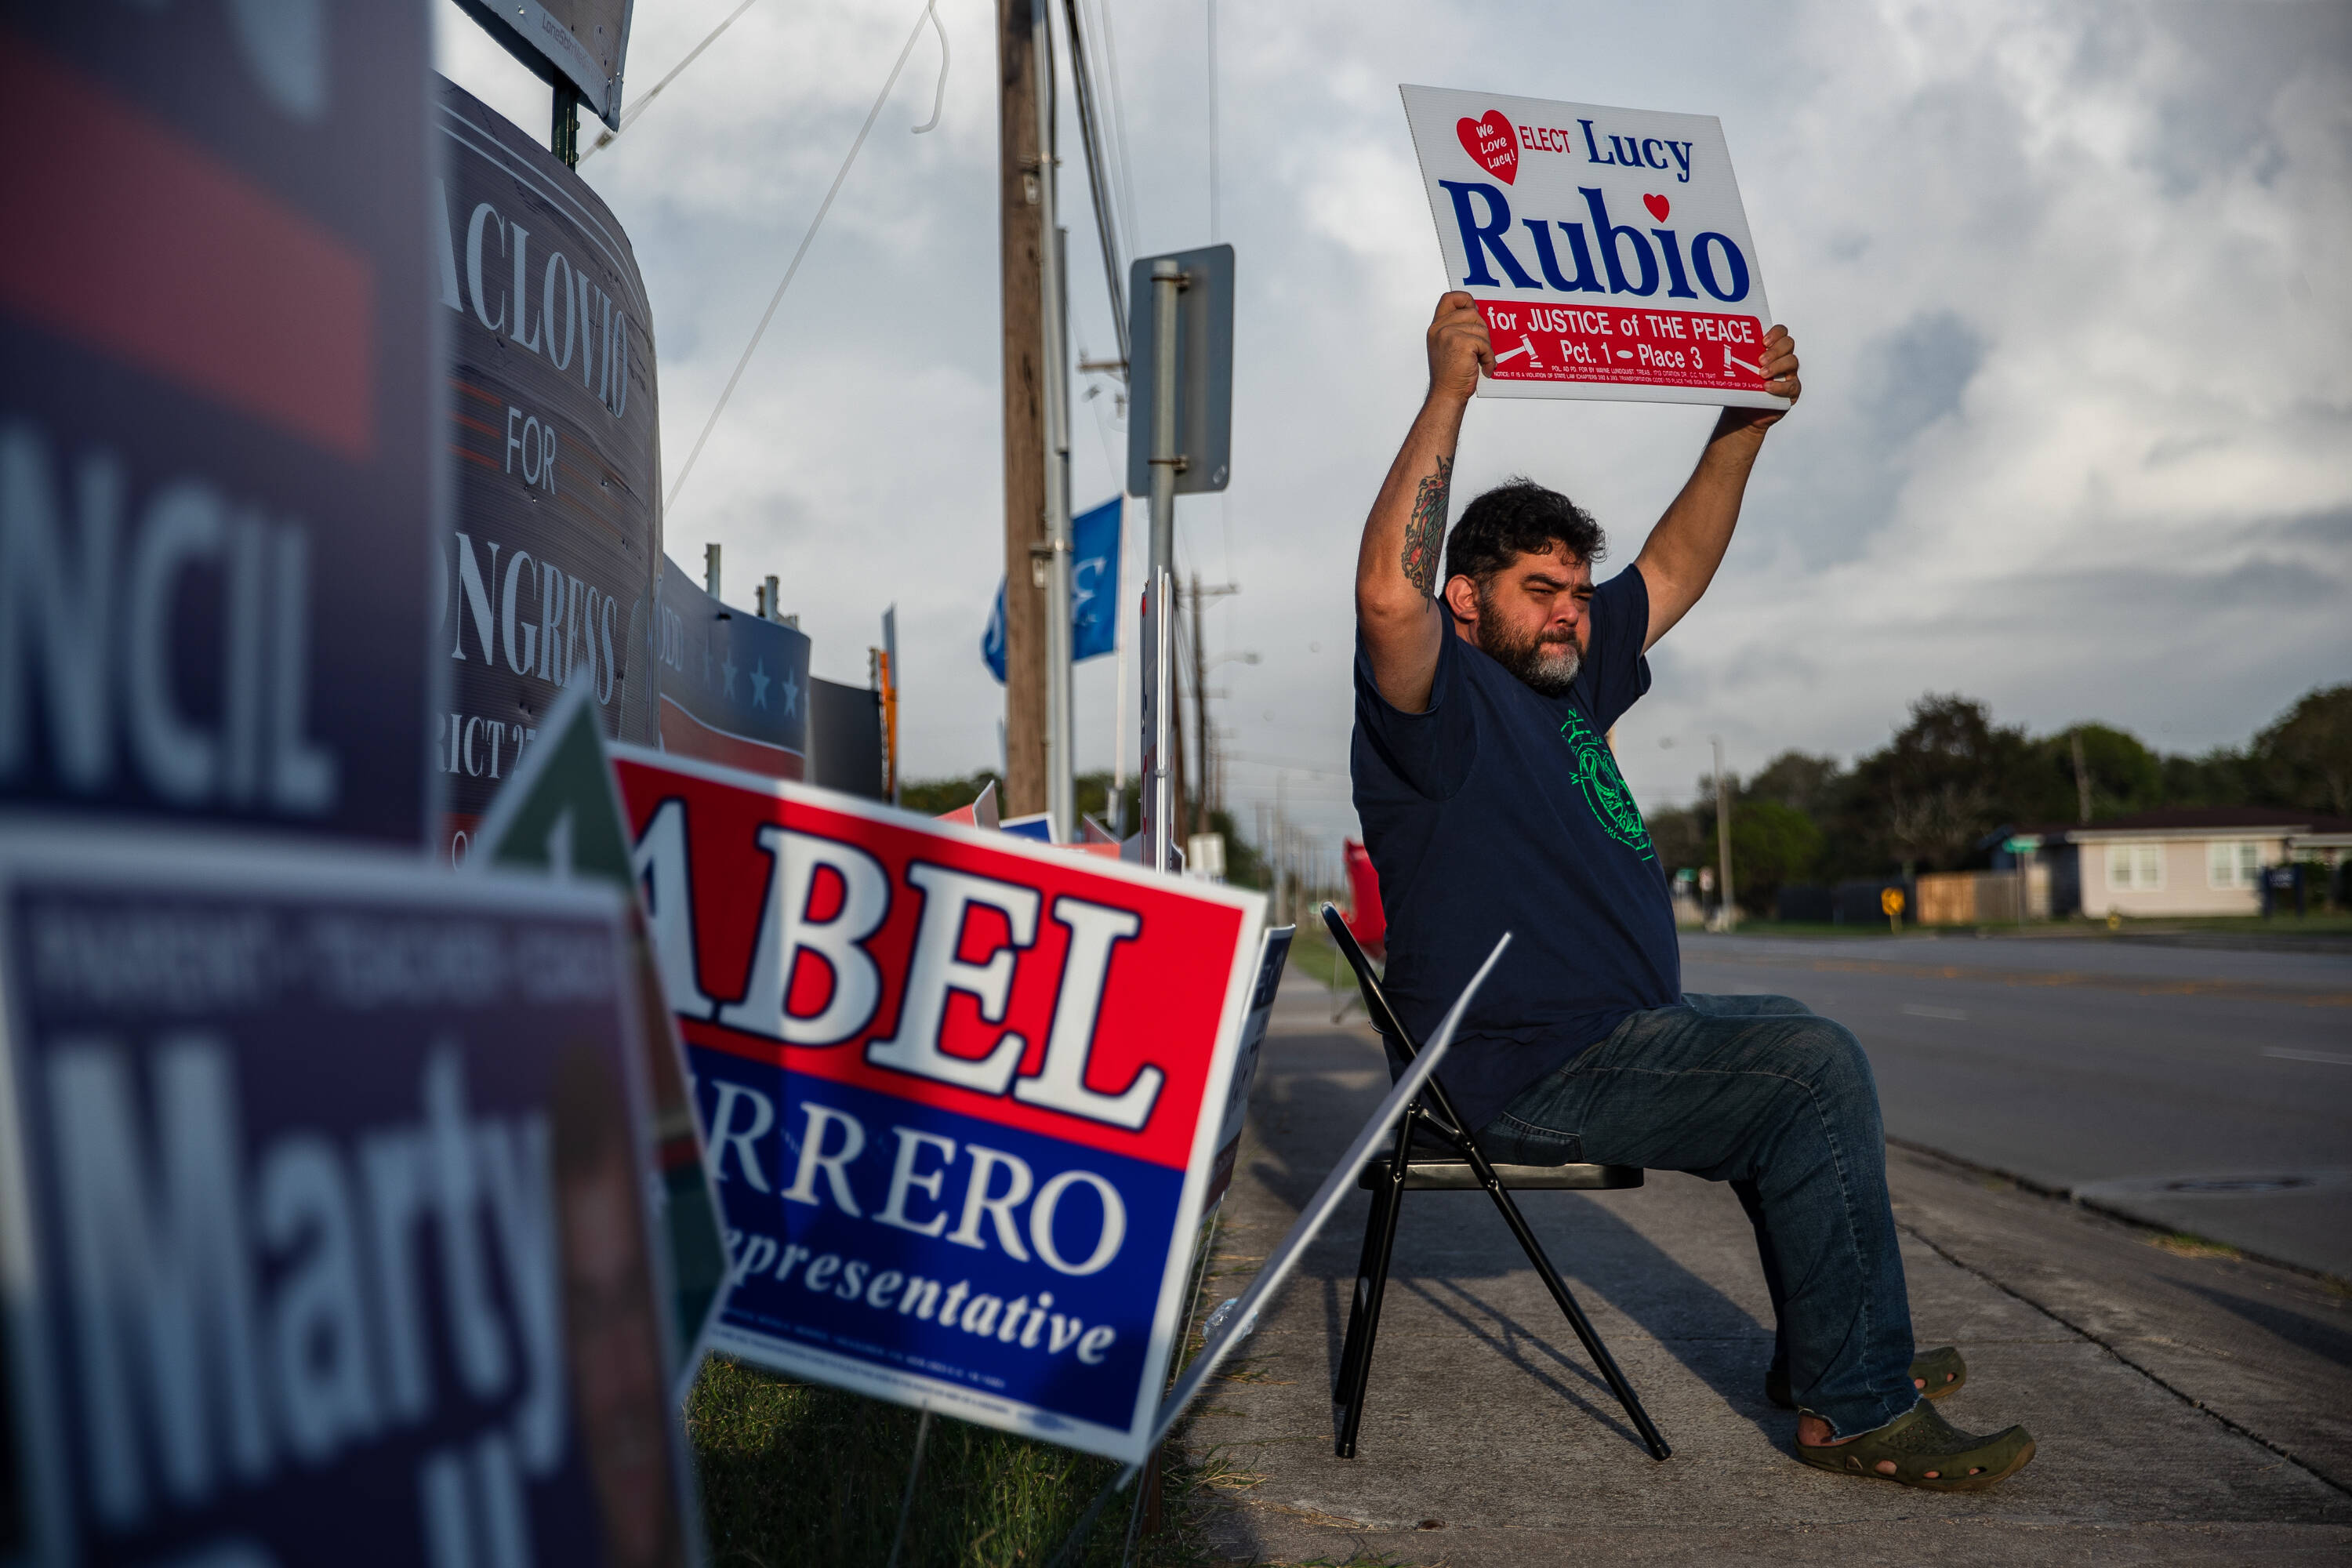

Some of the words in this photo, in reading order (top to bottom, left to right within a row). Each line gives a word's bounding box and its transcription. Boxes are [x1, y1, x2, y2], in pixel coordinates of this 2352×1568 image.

[1475, 122, 1494, 138] We
[1479, 136, 1508, 155] Love
[1486, 149, 1517, 171] Lucy!
[1518, 125, 1570, 154] ELECT
[1576, 118, 1693, 183] Lucy
[1437, 179, 1751, 303] Rubio
[1486, 307, 1518, 332] for
[1526, 308, 1611, 336] JUSTICE
[1619, 313, 1643, 337] of
[1645, 314, 1687, 340] THE
[1693, 318, 1755, 345] PEACE
[1559, 339, 1598, 364] Pct.
[1600, 341, 1612, 364] 1
[1636, 343, 1686, 368] Place
[1690, 346, 1704, 369] 3
[506, 405, 556, 495] FOR
[437, 531, 618, 706] NGRESS
[632, 797, 1167, 1132] ABEL
[691, 1073, 1128, 1277] RRERO
[47, 1031, 567, 1530] Marty
